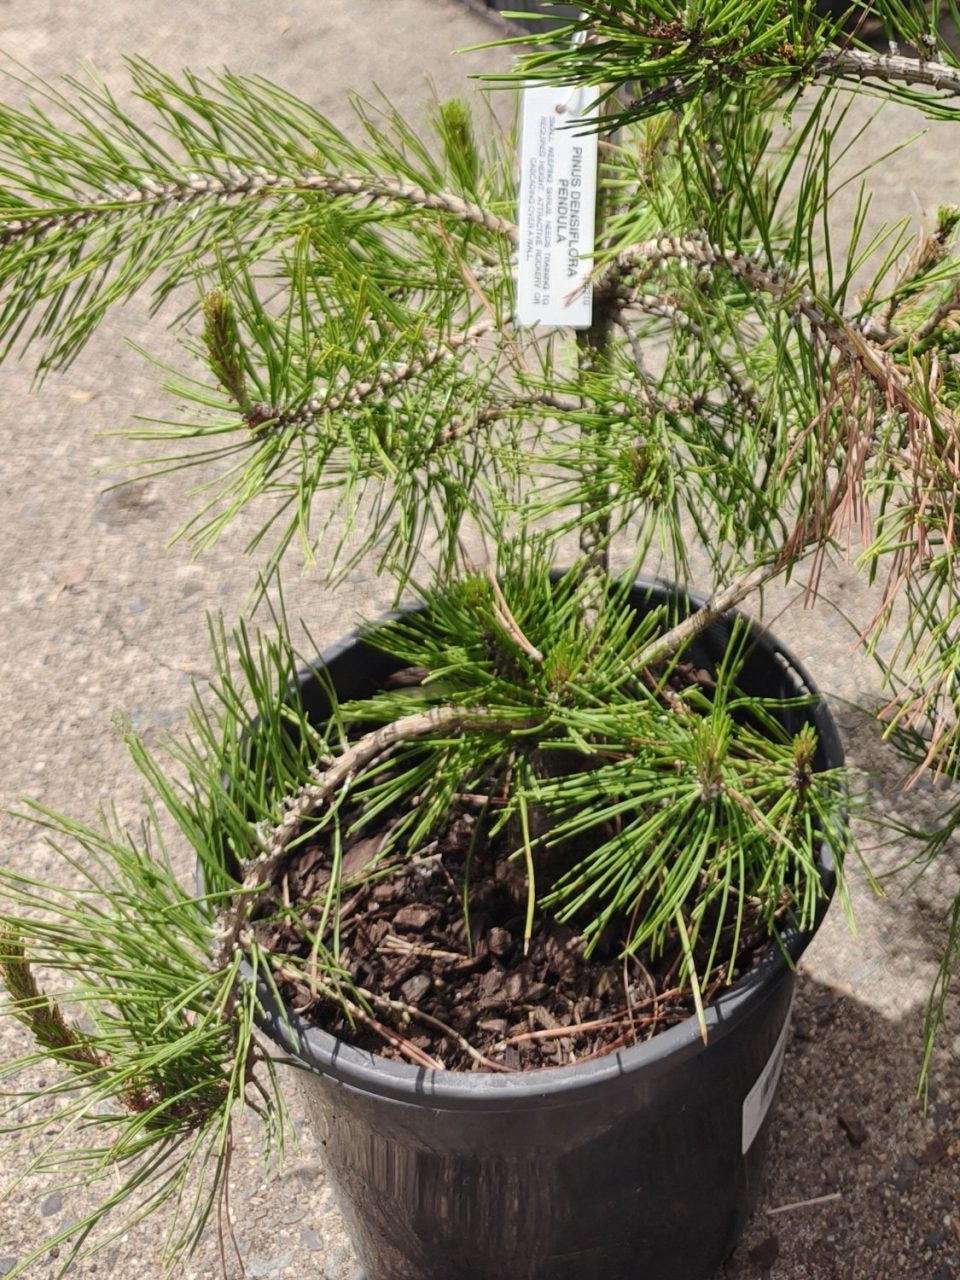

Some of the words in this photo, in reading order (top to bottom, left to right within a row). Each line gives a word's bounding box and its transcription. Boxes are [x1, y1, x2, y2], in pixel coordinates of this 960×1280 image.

[571, 146, 583, 188] PINUS
[556, 179, 569, 243] PENDULA
[567, 190, 582, 278] DENSIFLORA
[542, 295, 550, 305] TO
